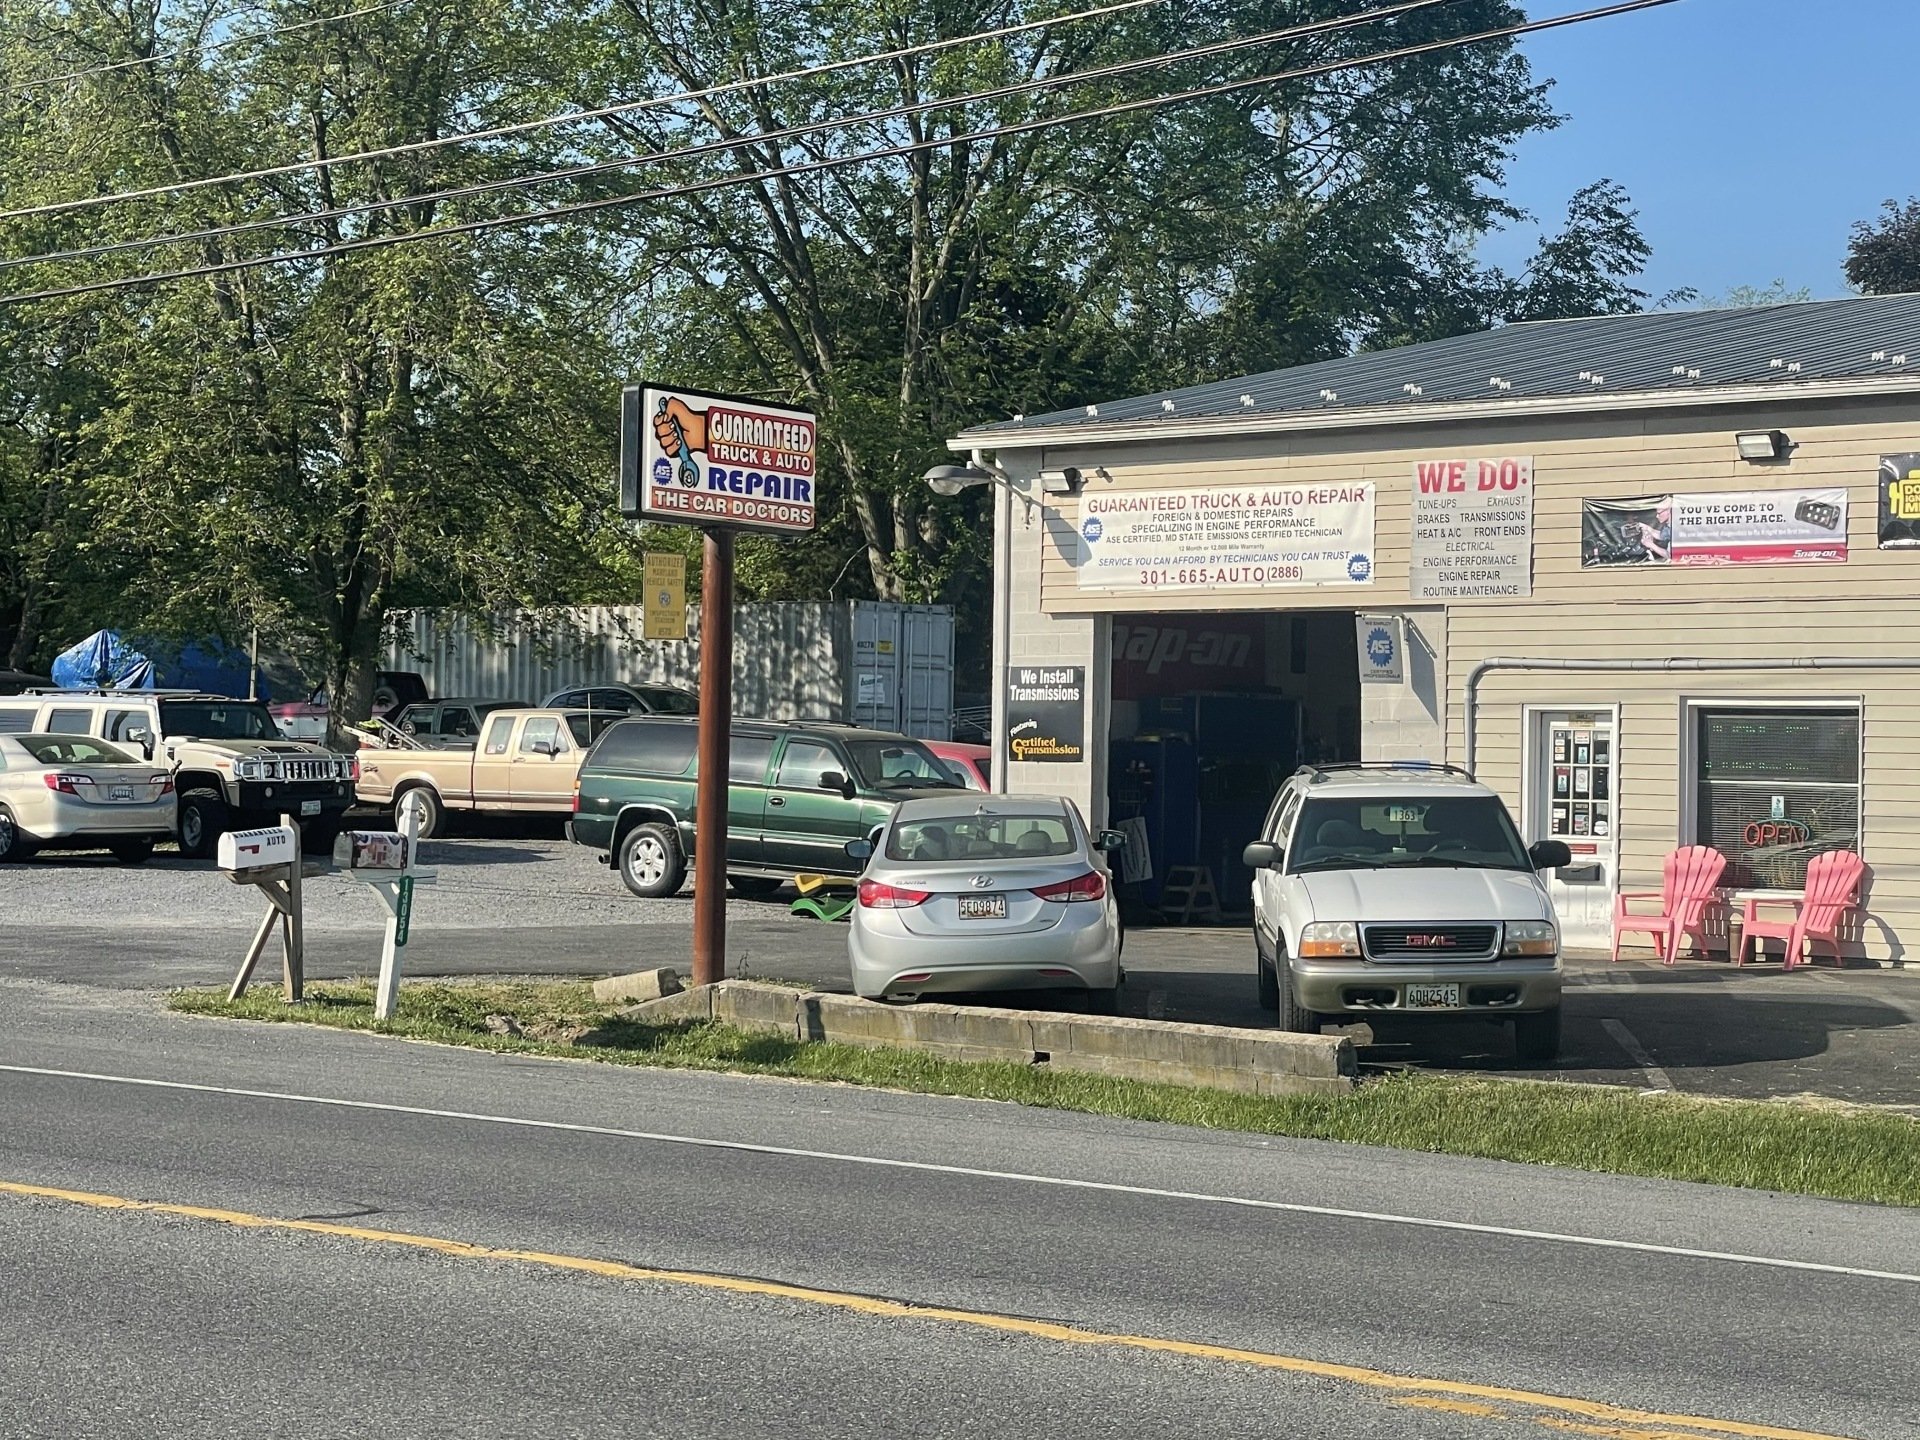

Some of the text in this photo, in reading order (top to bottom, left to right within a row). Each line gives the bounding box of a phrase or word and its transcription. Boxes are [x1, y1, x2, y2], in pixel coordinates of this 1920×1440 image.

[711, 411, 813, 453] GUARANTEED
[711, 443, 811, 471] TRUCK & AUTO
[1417, 459, 1527, 494] WE DO:
[708, 467, 811, 502] REPAIR
[1088, 488, 1365, 513] GUARANTEED TRUCK & AUTO REPAIR
[1418, 499, 1457, 509] TUNE-UPS
[1487, 496, 1527, 507] EXHAUST
[655, 490, 811, 524] THE CAR DOCTORS
[1680, 503, 1774, 515] YOU'VE COME TO
[1905, 503, 1920, 513] M
[1152, 508, 1293, 522] FOREIGN & DOMESTIC REPAIRS
[1417, 514, 1450, 524] BRAKES
[1460, 511, 1526, 523] TRANSMISSIONS
[1679, 514, 1787, 526] THE RIGHT PLACE.
[1084, 524, 1101, 534] ASE
[1131, 518, 1316, 533] SPECIALIZING IN ENGINE PERFORMANCE
[1474, 526, 1526, 537] FRONT ENDS
[1106, 536, 1121, 544] ASE
[1165, 533, 1177, 542] MD
[1179, 532, 1203, 541] STATE
[1207, 531, 1249, 541] EMISSIONS
[1251, 530, 1292, 539] CERTIFIED
[1295, 528, 1343, 538] TECHNICIAN
[1417, 528, 1462, 538] HEAT & A/C
[1445, 541, 1495, 552] ELECTRICAL
[1099, 551, 1350, 567] SERVICE YOU CAN AFFORD BY TECHNICIANS YOU CAN TRUST
[1792, 549, 1837, 560] Snap-on
[1423, 555, 1517, 567] ENGINE PERFORMANCE
[1350, 562, 1367, 573] ASE
[1438, 570, 1501, 581] ENGINE REPAIR
[1423, 585, 1518, 597] ROUTINE MAINTENANCE
[1370, 640, 1390, 654] ASE
[1020, 669, 1074, 685] We Install
[1010, 684, 1080, 701] Transmissions
[1011, 737, 1056, 754] Certified
[1015, 744, 1080, 760] Transmission
[1394, 809, 1415, 821] 1363
[267, 835, 286, 846] AUTO
[1744, 823, 1806, 848] OPEN
[397, 878, 409, 942] 13054
[1406, 934, 1457, 946] GMC
[1409, 989, 1457, 1003] 6DH2545
